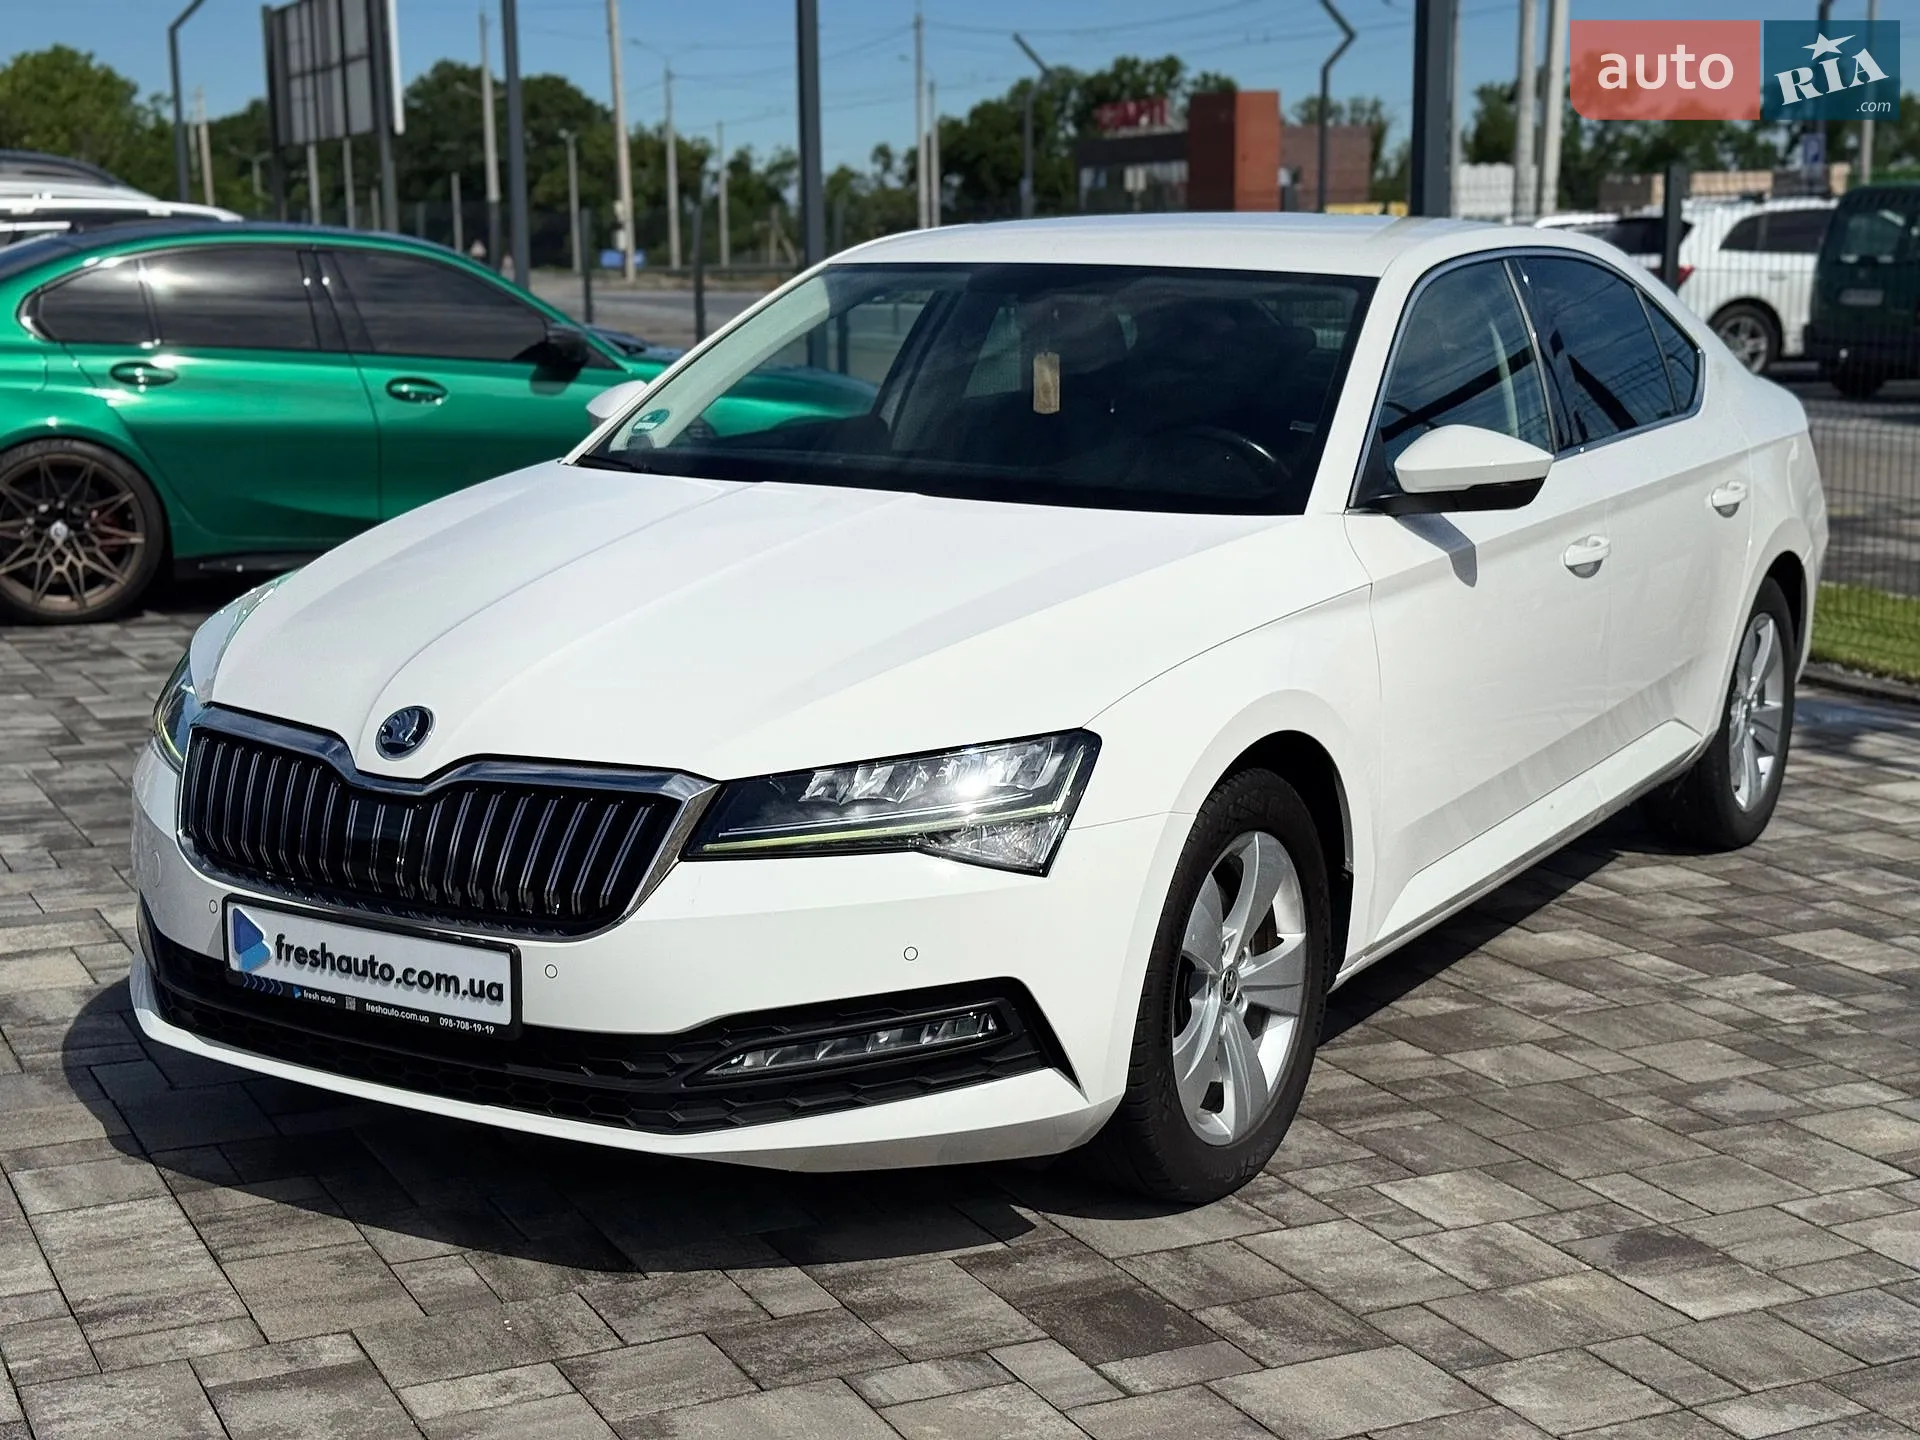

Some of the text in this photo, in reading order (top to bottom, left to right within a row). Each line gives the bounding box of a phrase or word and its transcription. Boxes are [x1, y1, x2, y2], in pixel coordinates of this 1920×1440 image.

[274, 933, 504, 1002] freshauto.com.ua
[303, 989, 336, 1005] fresh auto
[365, 1002, 430, 1023] freshauto.com.ua
